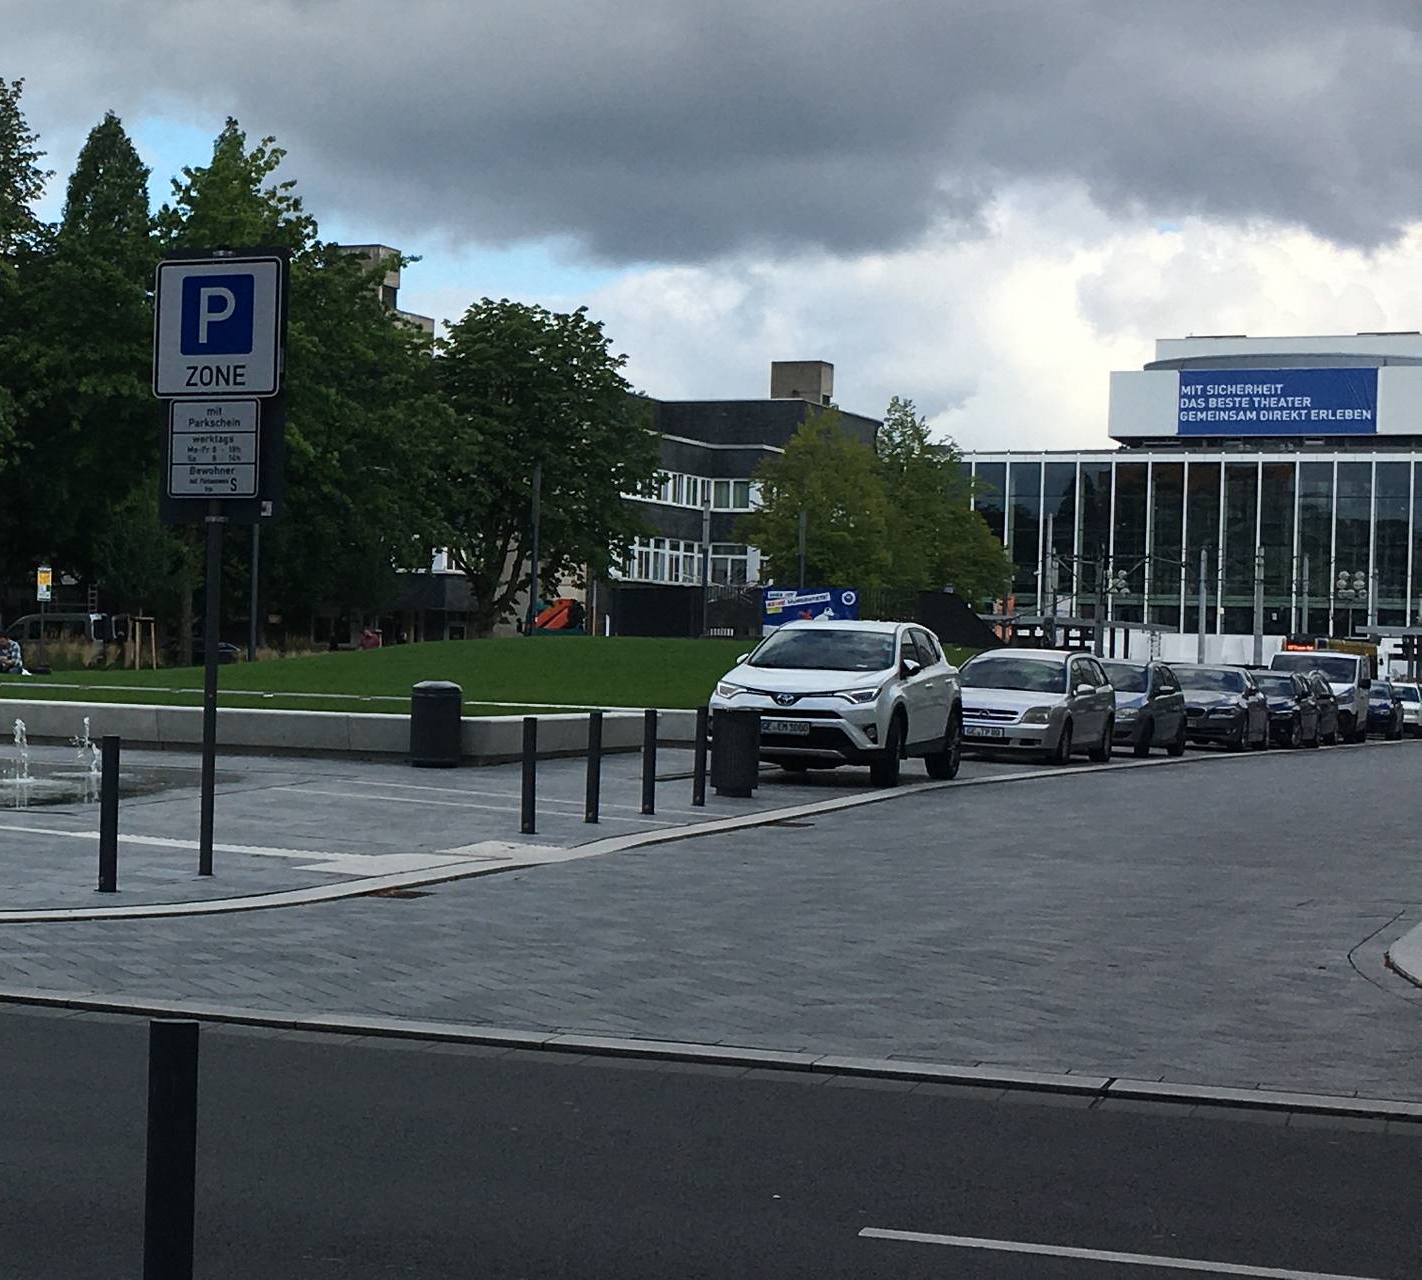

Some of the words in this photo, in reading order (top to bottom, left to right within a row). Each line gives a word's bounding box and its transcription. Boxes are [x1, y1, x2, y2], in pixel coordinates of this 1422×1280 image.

[199, 287, 236, 343] P
[186, 365, 246, 387] ZONE
[1181, 385, 1204, 395] MIT
[1206, 384, 1284, 395] SICHERHEIT
[1180, 398, 1205, 408] DAS
[1208, 397, 1249, 408] BESTE
[1253, 397, 1311, 408] THEATER
[207, 407, 223, 415] mit
[1180, 411, 1257, 421] GEMEINSAM
[1260, 410, 1308, 420] DIREKT
[1310, 409, 1372, 420] ERLEBEN
[188, 418, 241, 427] Parkschein
[193, 435, 234, 445] werktags
[189, 466, 235, 475] Bewohner
[230, 478, 238, 492] S
